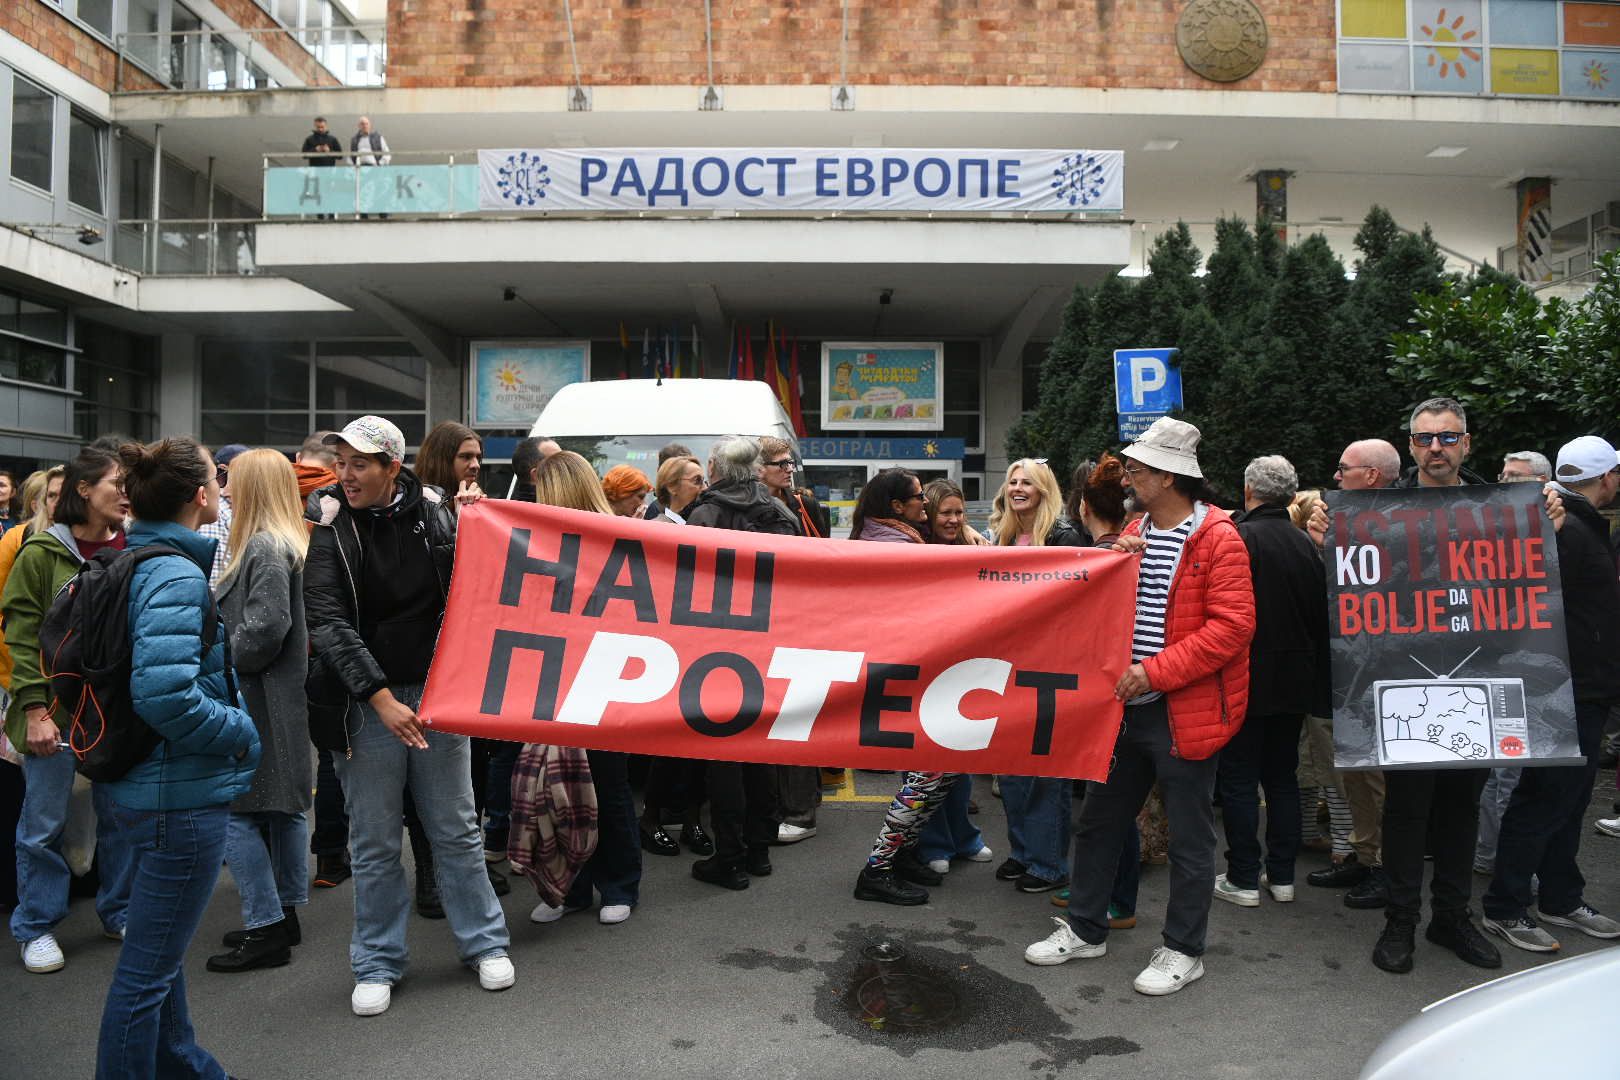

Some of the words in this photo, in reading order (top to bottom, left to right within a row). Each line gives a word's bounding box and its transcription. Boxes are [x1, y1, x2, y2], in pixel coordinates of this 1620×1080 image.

[580, 157, 797, 206] РАДОСТ
[815, 157, 1021, 198] ЕВРОПЕ
[1130, 356, 1168, 406] P
[498, 527, 775, 633] НАШ
[977, 567, 1089, 585] #nasprotest
[1335, 544, 1382, 586] KO
[1447, 537, 1547, 582] KRIJE
[1338, 589, 1449, 636] BOLJE
[1449, 588, 1469, 606] DA
[1471, 585, 1553, 631] NIJE
[1451, 615, 1470, 633] GA
[479, 628, 1079, 757] ПРОТЕСТ
